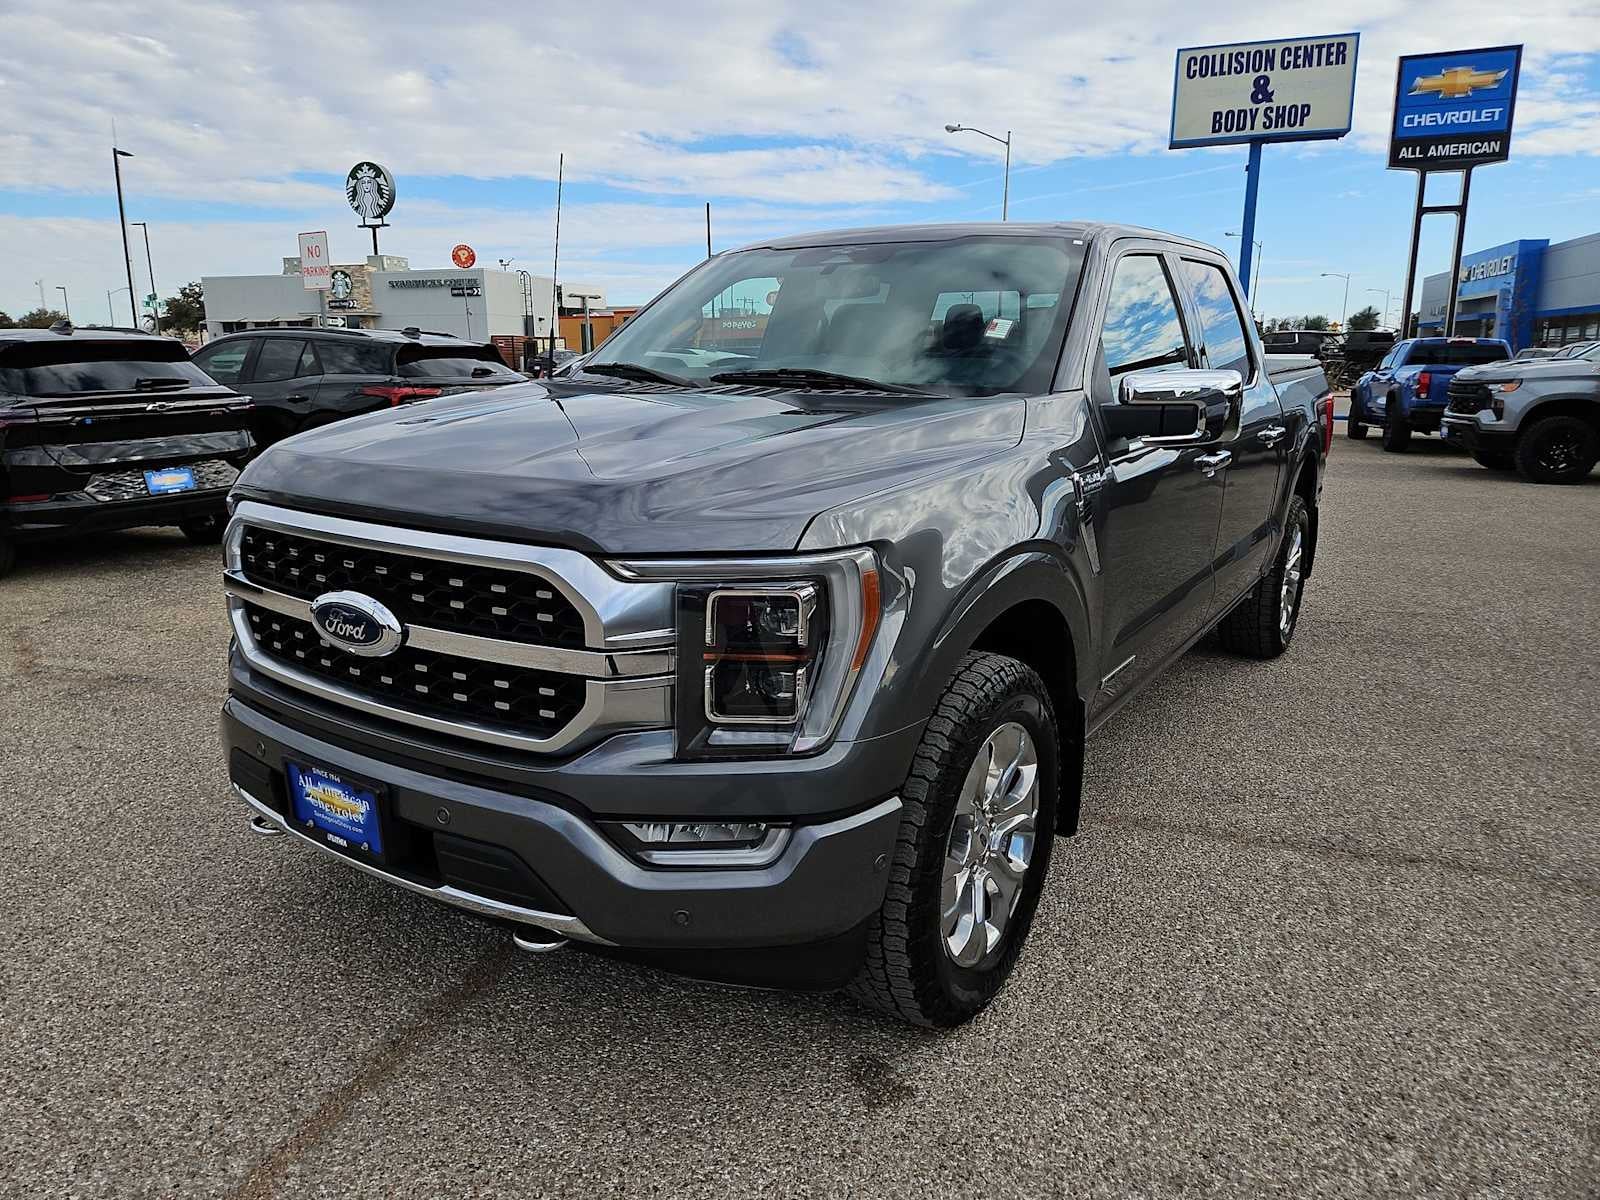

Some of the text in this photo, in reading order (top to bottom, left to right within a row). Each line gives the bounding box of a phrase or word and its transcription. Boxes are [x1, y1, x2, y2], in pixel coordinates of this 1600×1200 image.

[1186, 42, 1347, 80] COLLISION CENTER
[1250, 74, 1275, 105] &
[1211, 103, 1311, 134] BODY SHOP
[1402, 107, 1504, 128] CHEVROLET
[1398, 141, 1500, 159] ALL AMERICAN
[307, 245, 320, 258] NO
[303, 265, 330, 277] PARKING
[1470, 255, 1513, 281] CHEVROLET
[325, 607, 367, 640] Ford
[298, 774, 370, 812] All American
[309, 794, 364, 825] Chevrolet
